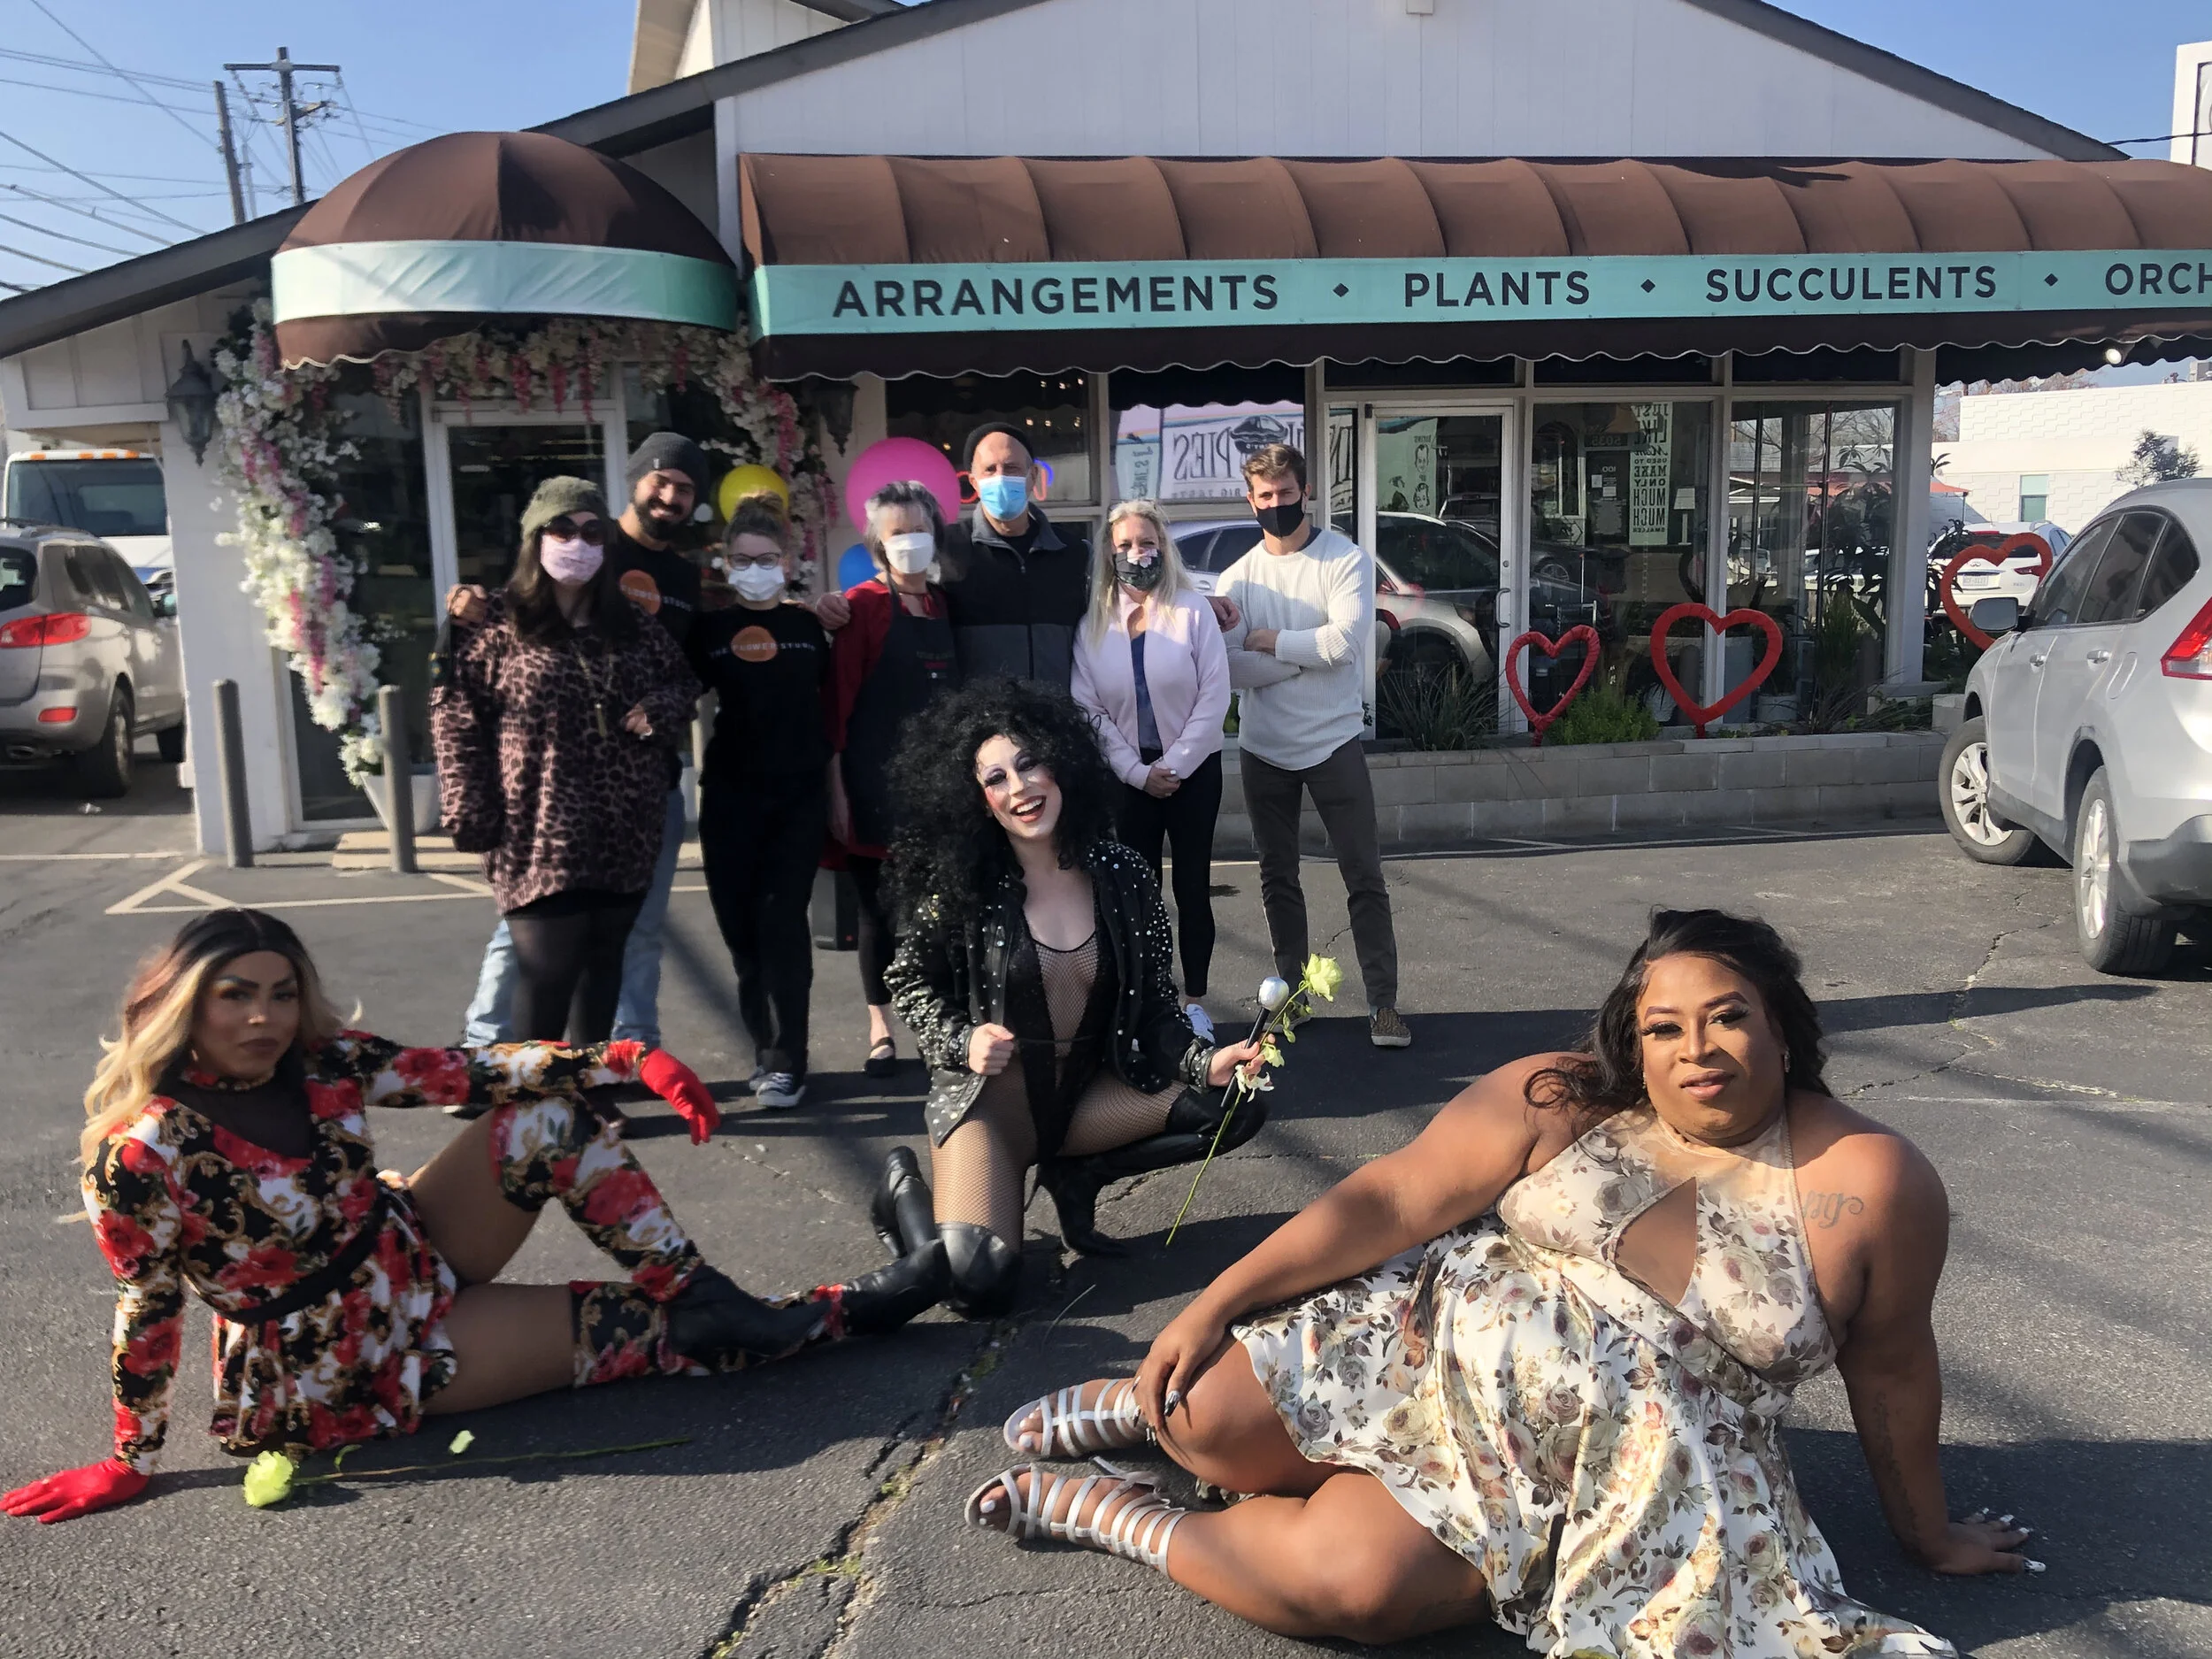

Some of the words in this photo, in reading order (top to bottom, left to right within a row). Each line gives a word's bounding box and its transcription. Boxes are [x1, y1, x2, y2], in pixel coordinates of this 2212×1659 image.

[833, 274, 1279, 318] ARRANGEMENTS
[1405, 270, 1590, 307] PLANTS
[1705, 265, 1997, 303] SUCCULENTS
[732, 642, 778, 651] FLOWER
